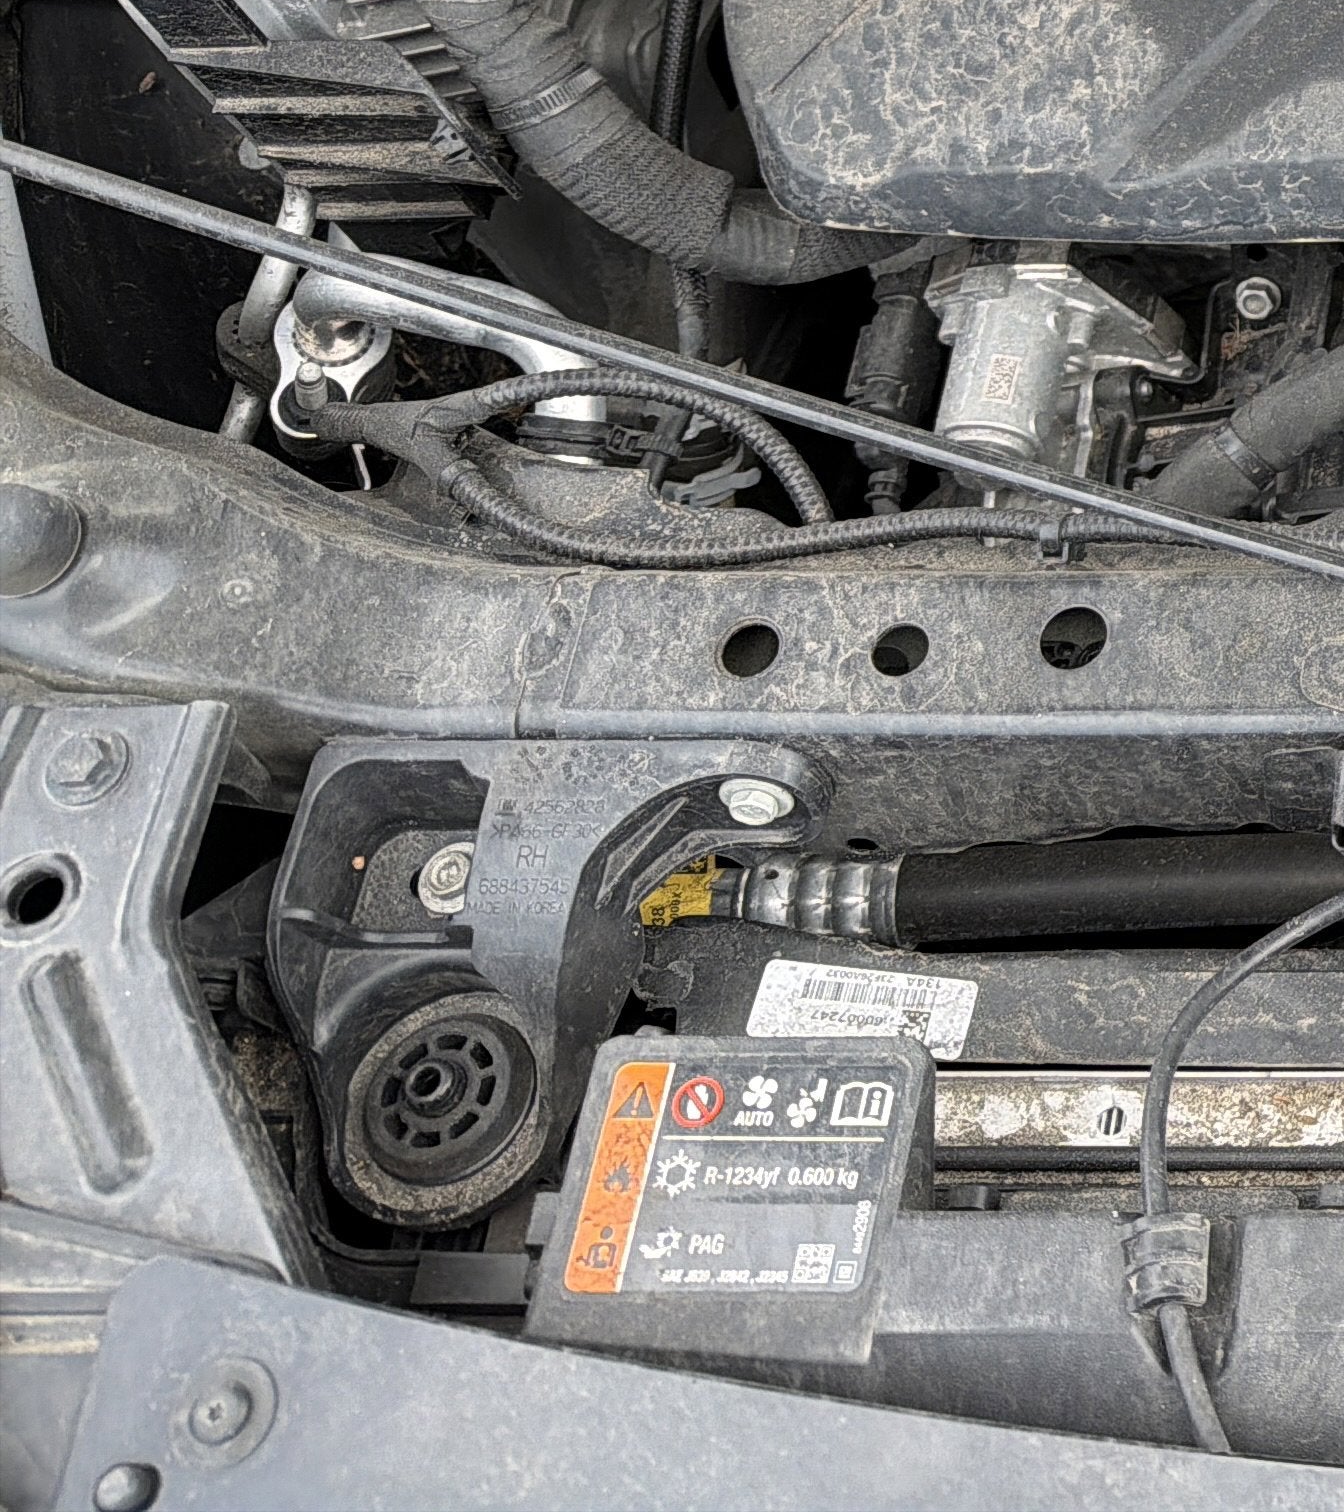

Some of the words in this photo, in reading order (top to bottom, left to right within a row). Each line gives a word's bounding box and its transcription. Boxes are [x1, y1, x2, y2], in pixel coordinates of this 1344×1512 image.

[516, 844, 549, 868] RH
[526, 901, 567, 915] KOREA
[733, 1110, 774, 1127] AUTO
[704, 1166, 780, 1189] R-1234yf
[788, 1166, 834, 1186] 0.600
[837, 1167, 859, 1190] kg
[688, 1234, 725, 1255] PAG
